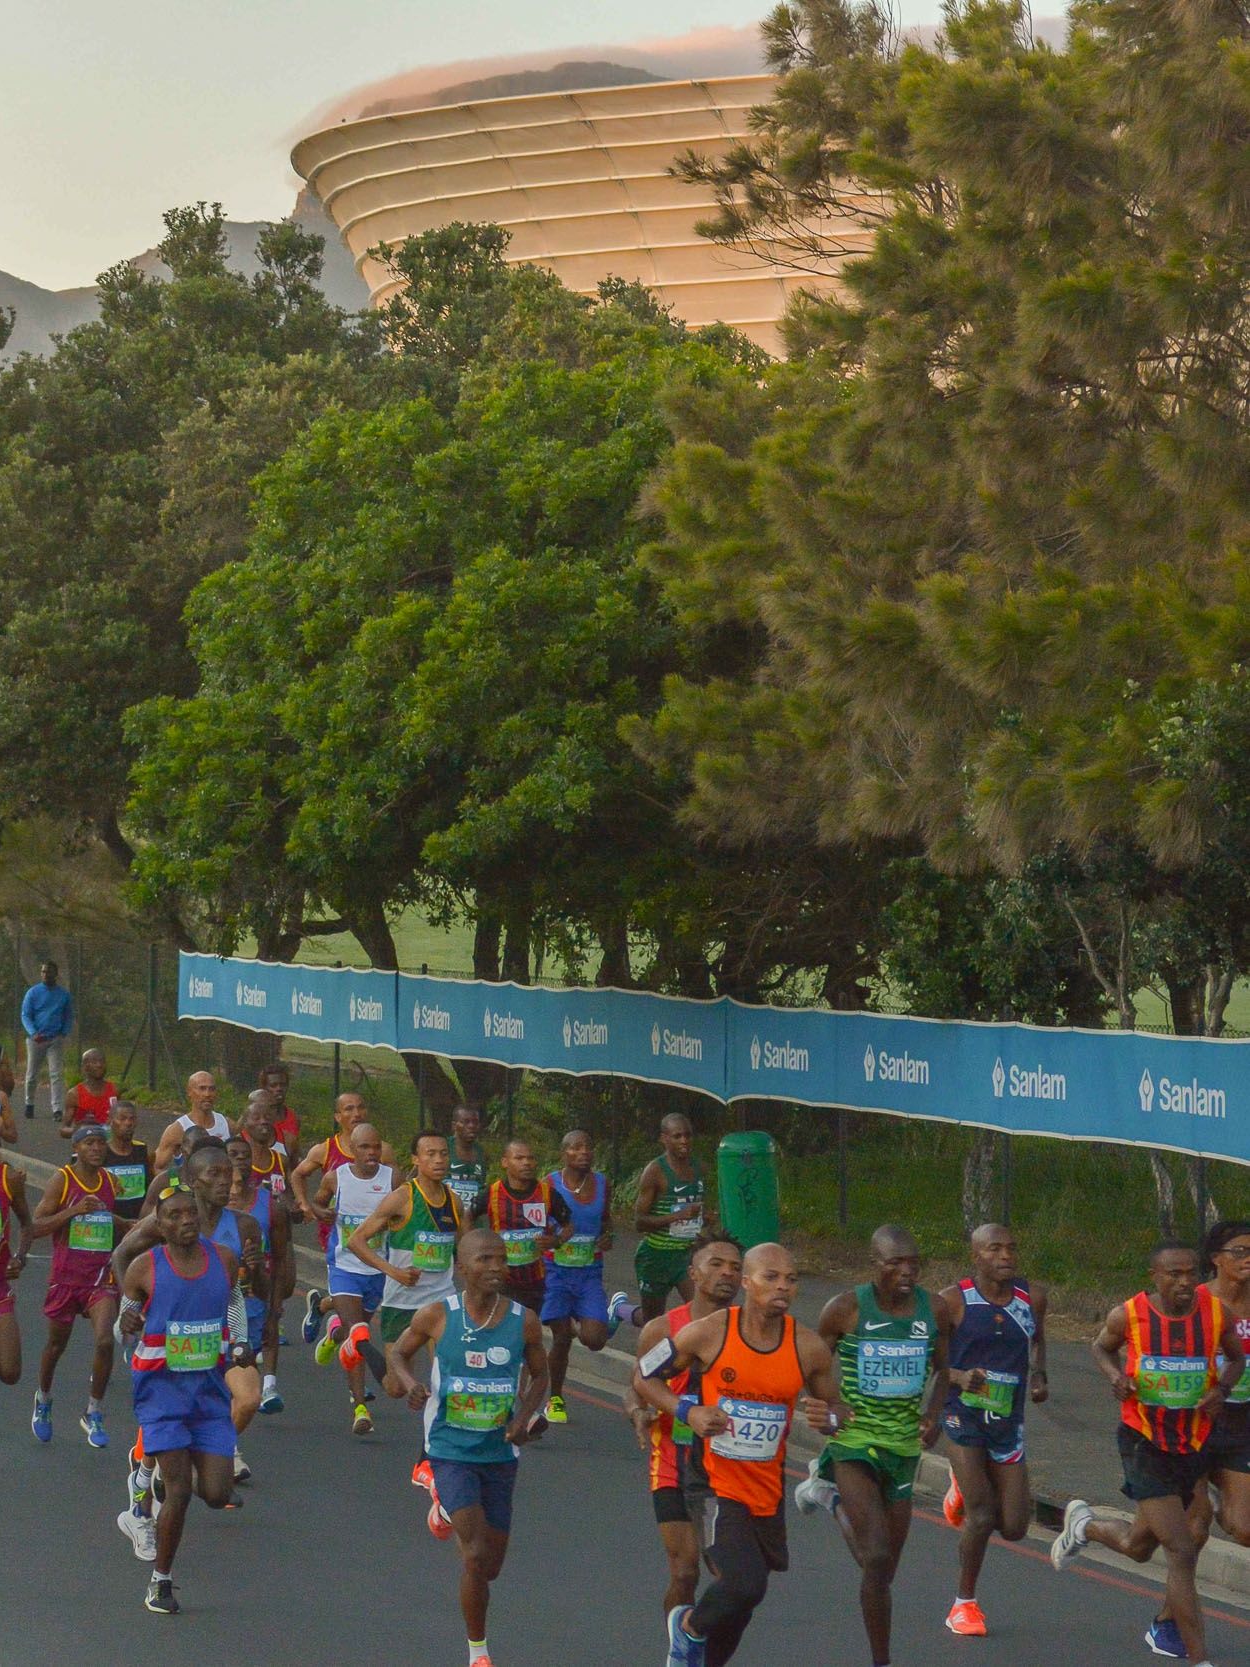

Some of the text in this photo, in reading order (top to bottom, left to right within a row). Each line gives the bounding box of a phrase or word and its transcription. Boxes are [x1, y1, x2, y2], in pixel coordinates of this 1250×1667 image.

[194, 975, 213, 998] Sanlam
[243, 984, 267, 1009] Sanlam
[298, 992, 322, 1016] Sanlam
[356, 998, 383, 1022] Sanlam
[421, 1005, 450, 1030] Sanlam
[492, 1012, 524, 1040] Sanlam
[573, 1019, 608, 1045] Sanlam
[662, 1028, 703, 1062] Sanlam
[763, 1041, 809, 1072] Sanlam
[878, 1050, 930, 1086] Sanlam
[1009, 1065, 1066, 1101] Sanlam
[1159, 1078, 1226, 1119] Sanlam
[114, 1167, 143, 1176] Sanlam
[527, 1207, 543, 1223] 40
[182, 1322, 221, 1335] Sanlam
[469, 1354, 483, 1367] 40
[877, 1344, 925, 1357] Sanlam
[863, 1360, 922, 1377] EZEKIEL
[1159, 1359, 1205, 1371] Sanlam
[467, 1381, 512, 1393] Sanlam
[860, 1378, 879, 1392] 29
[985, 1370, 1019, 1384] Sanlam
[737, 1404, 786, 1420] Sanlam
[724, 1417, 780, 1442] A420
